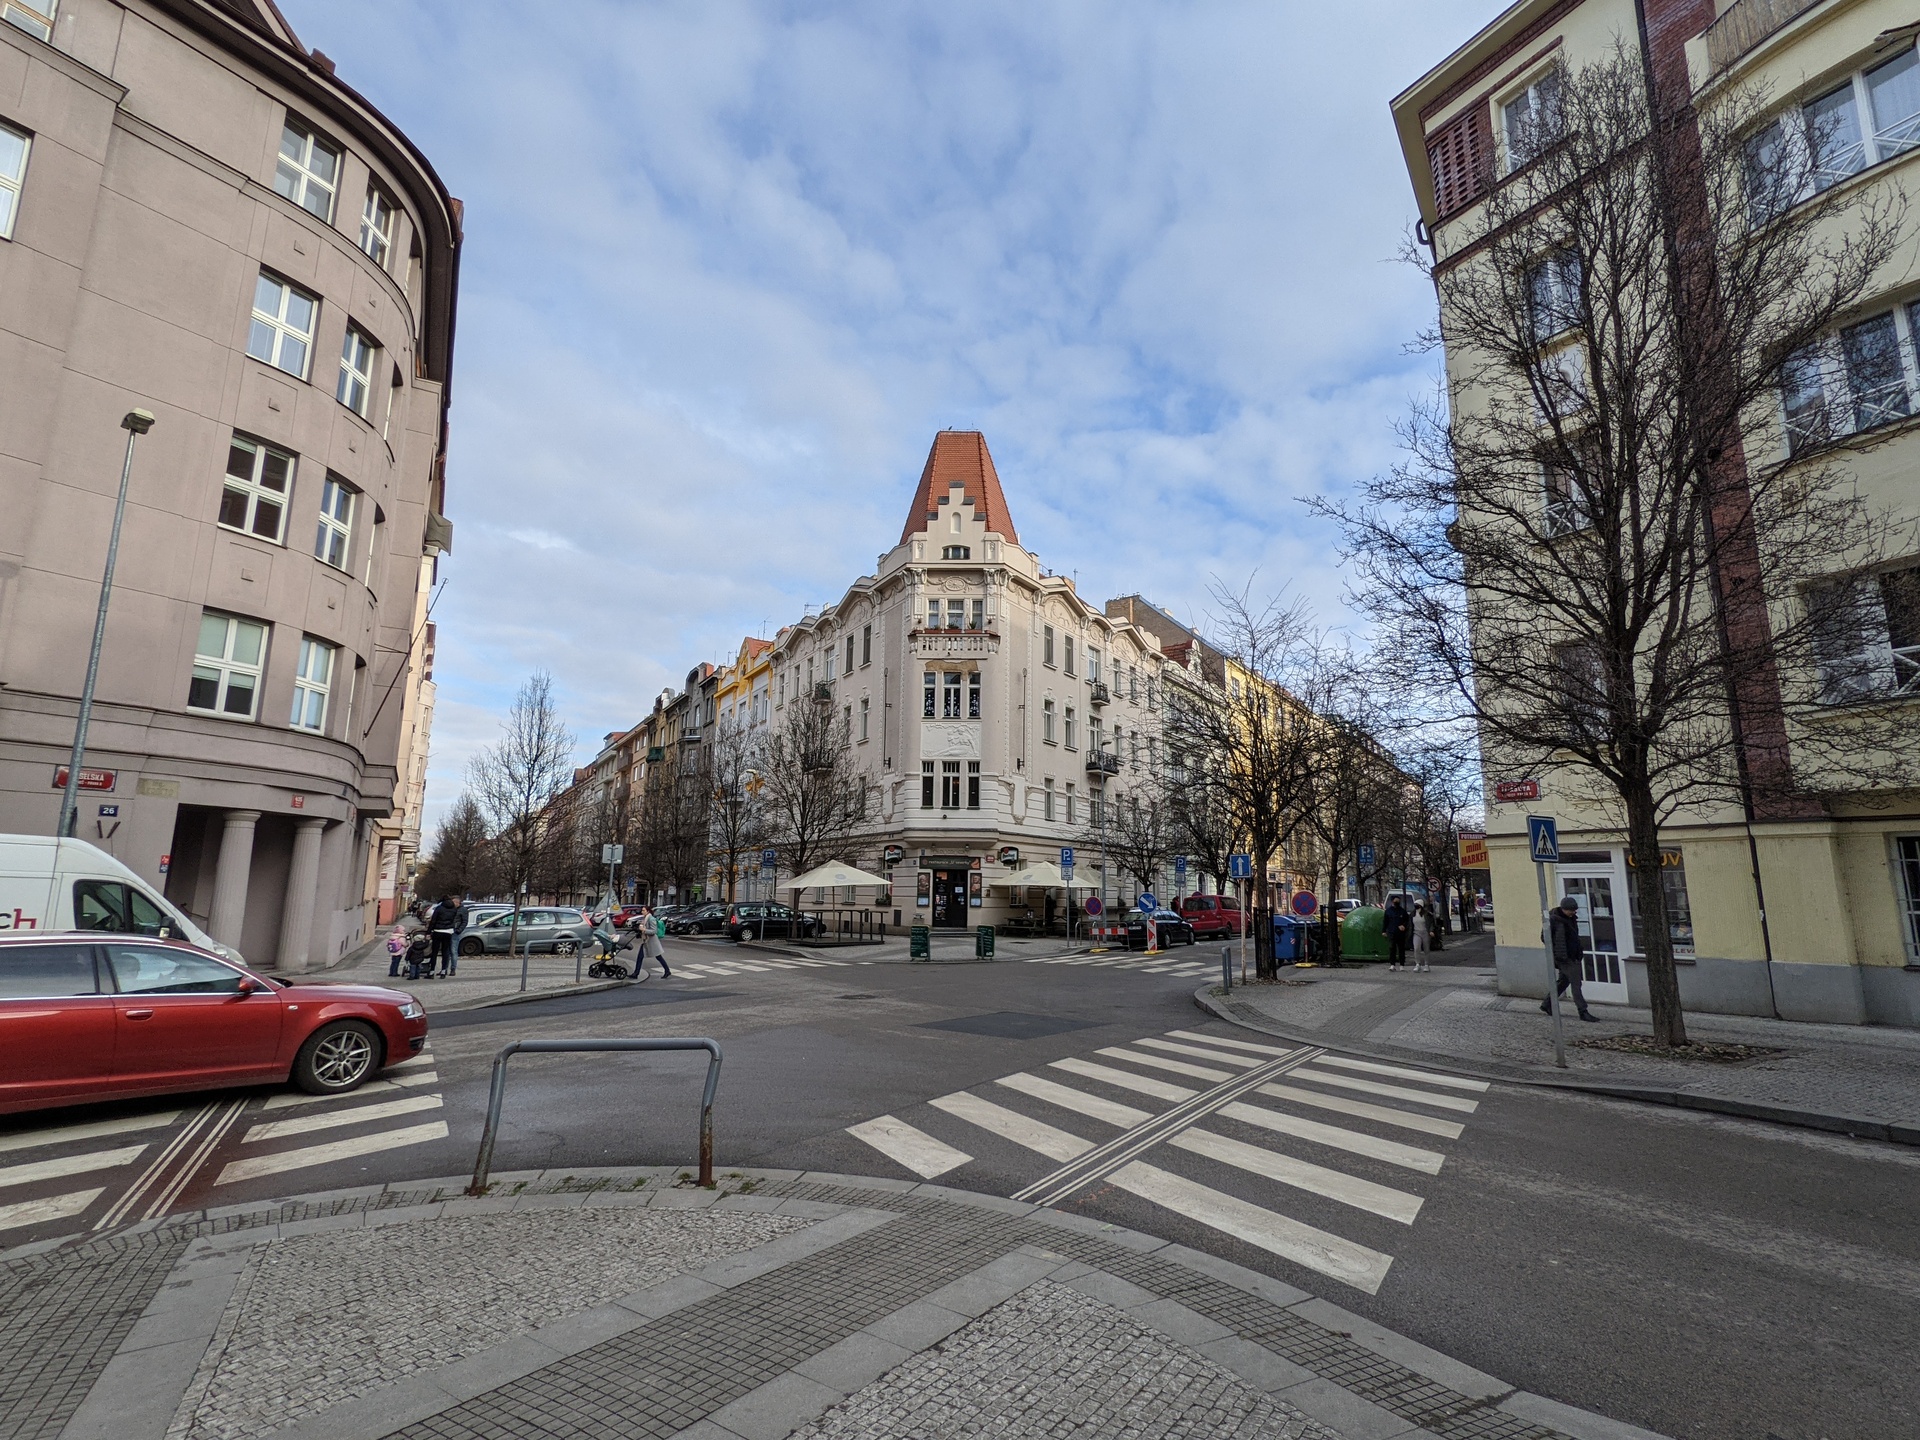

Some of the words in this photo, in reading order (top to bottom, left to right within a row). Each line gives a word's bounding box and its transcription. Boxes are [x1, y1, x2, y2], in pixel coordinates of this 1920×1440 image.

[79, 772, 104, 781] SELSKÁ
[1466, 841, 1481, 853] mini
[1063, 850, 1070, 860] P
[1461, 852, 1487, 866] MARKET
